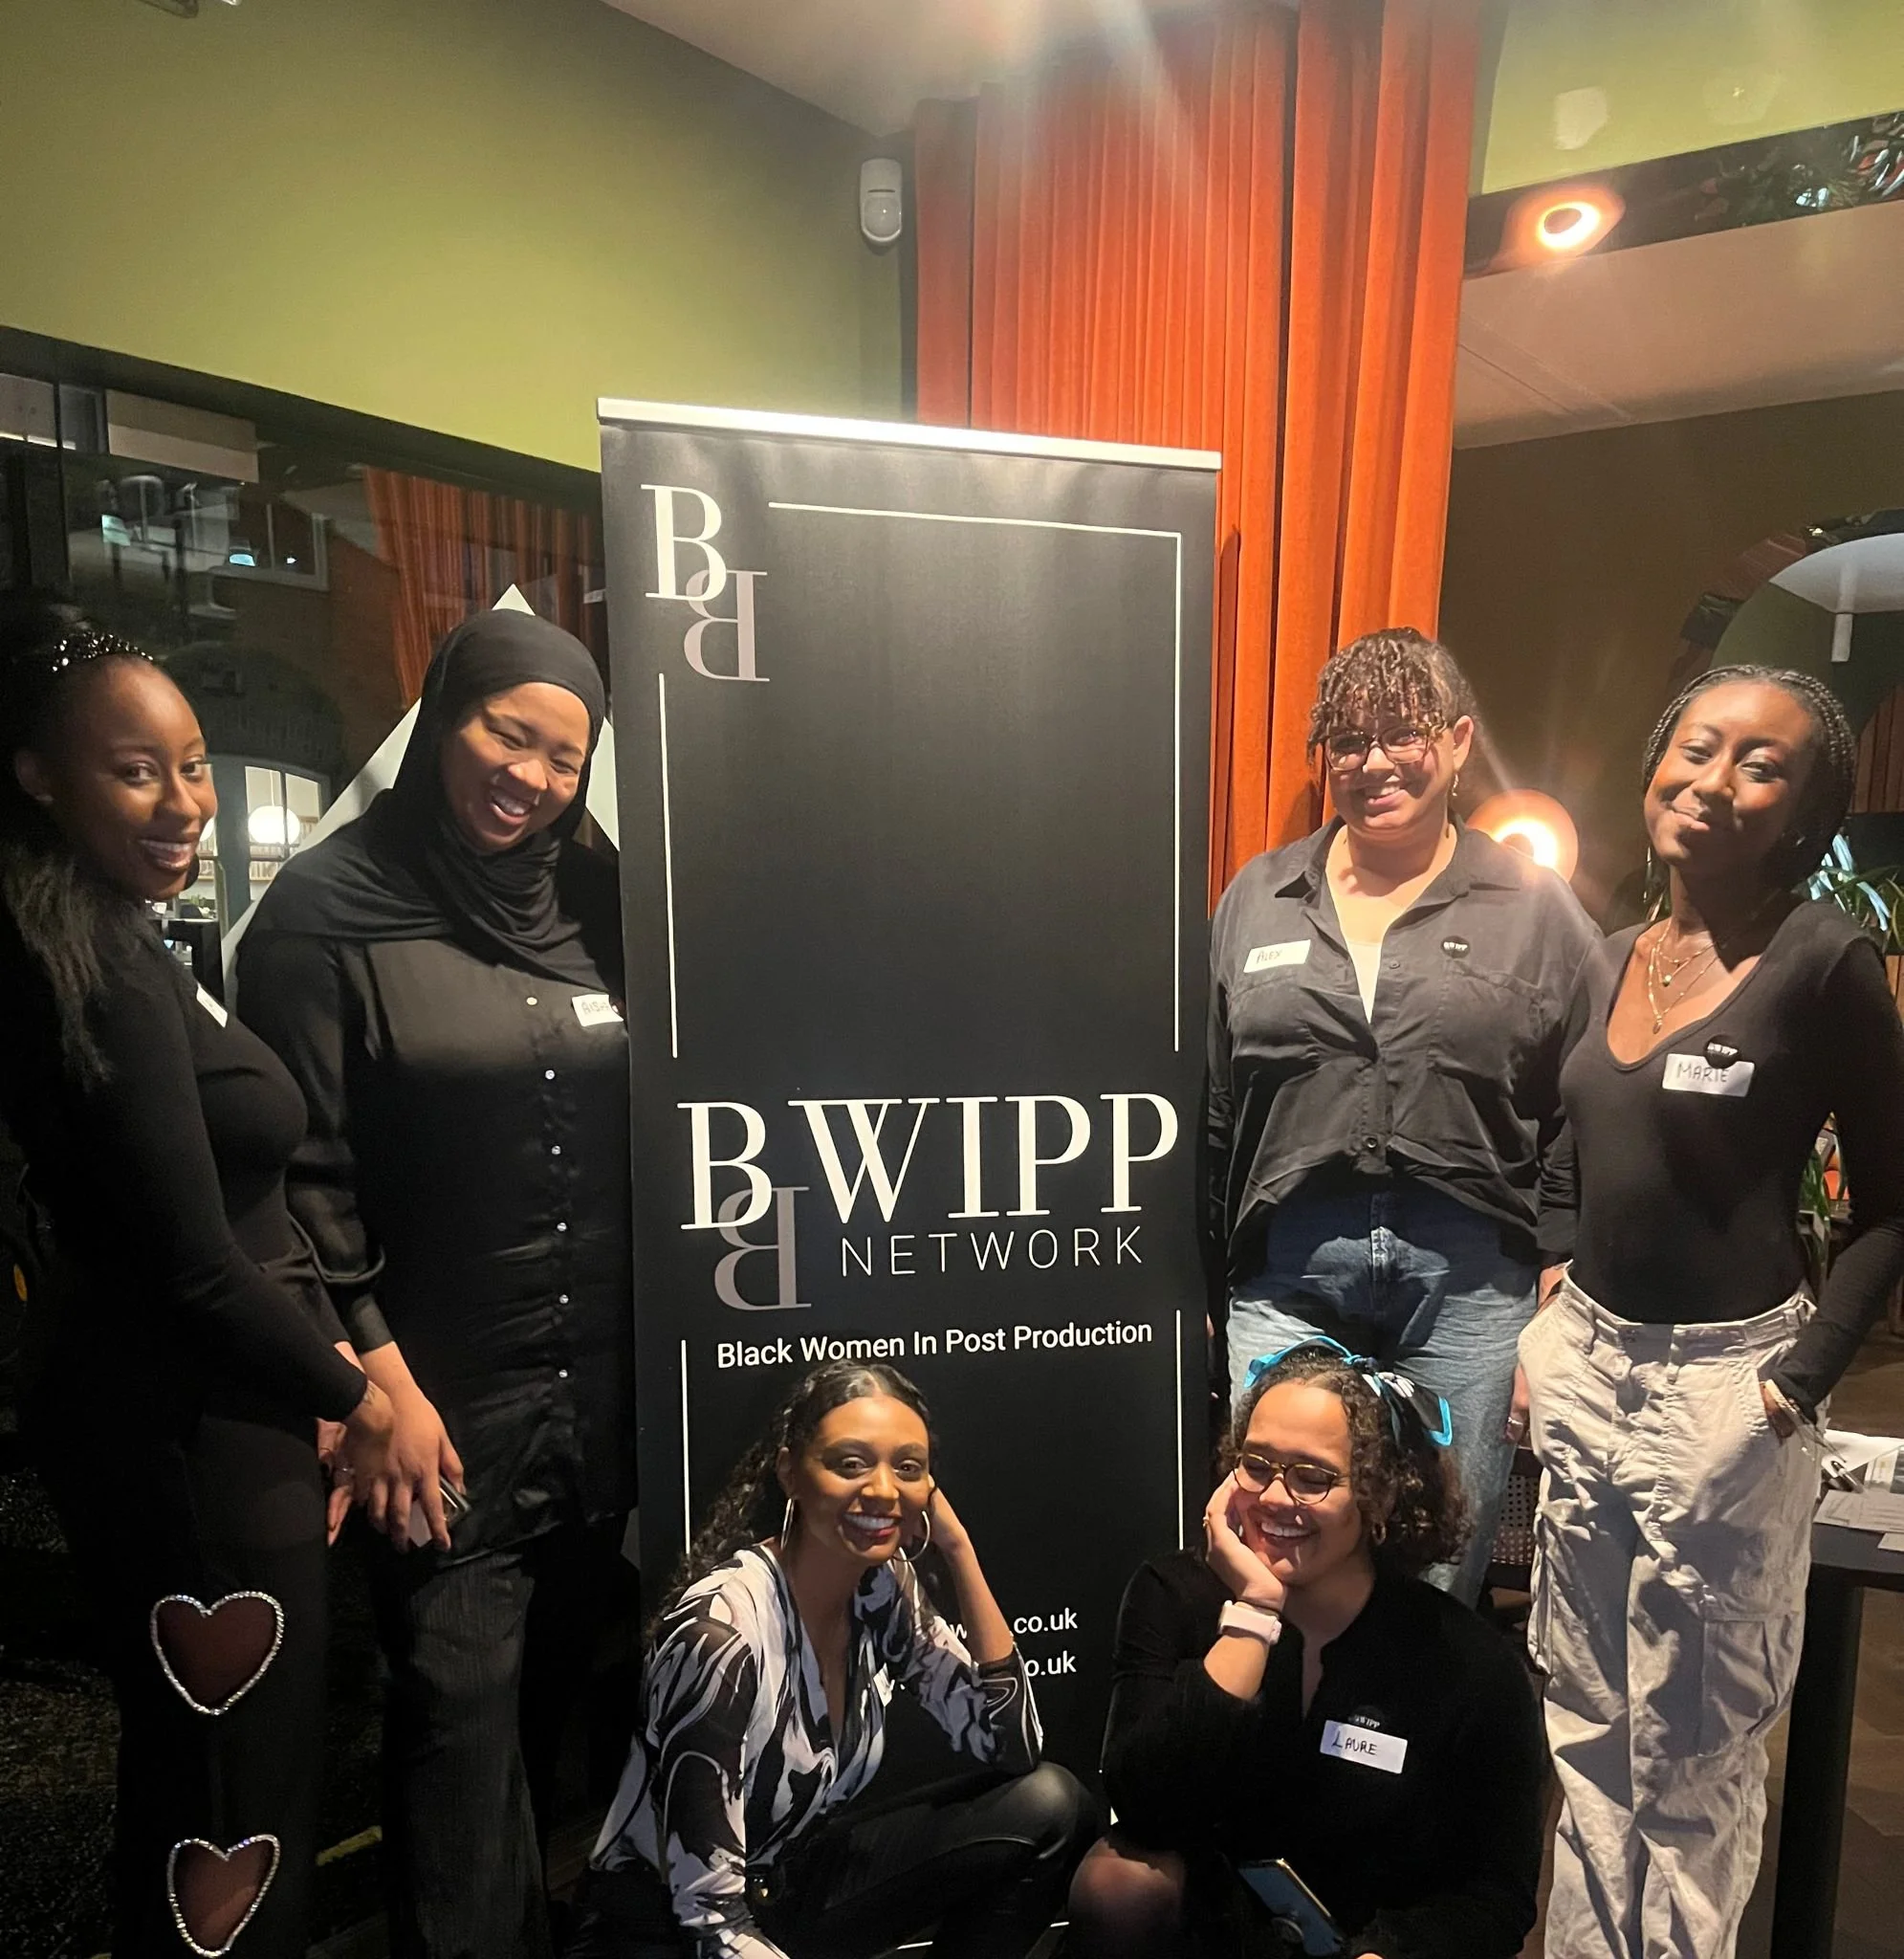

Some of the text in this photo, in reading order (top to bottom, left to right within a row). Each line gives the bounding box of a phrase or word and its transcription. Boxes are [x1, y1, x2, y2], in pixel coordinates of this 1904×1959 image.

[640, 484, 727, 602] B
[1675, 1062, 1730, 1083] MARIE
[841, 1225, 1144, 1278] NETWORK
[717, 1320, 1153, 1369] Black Women In Post Production
[1330, 1729, 1379, 1756] LAURE
